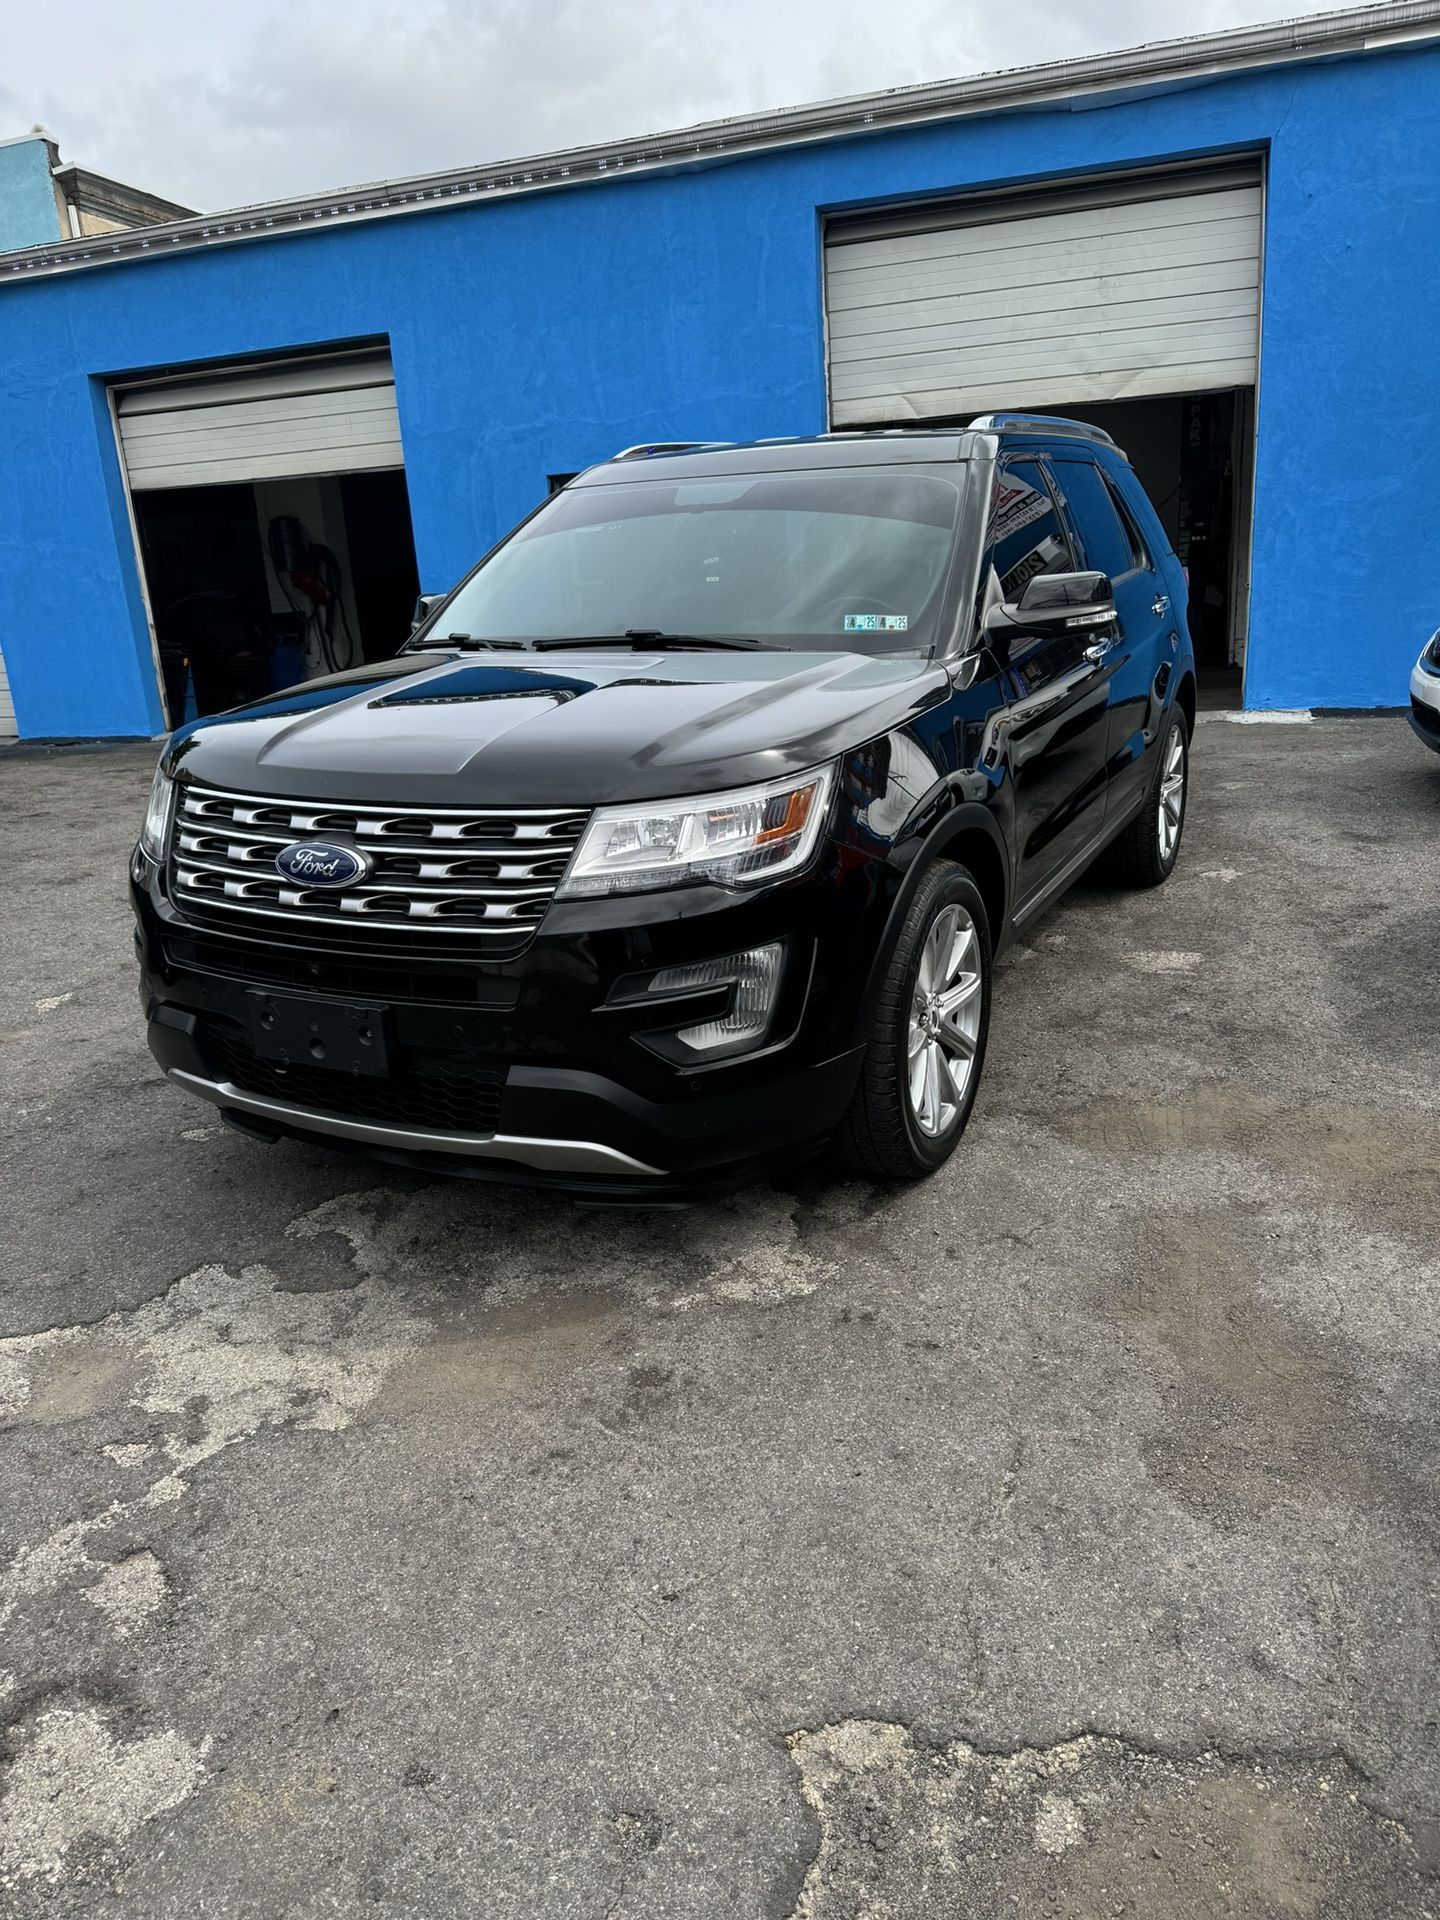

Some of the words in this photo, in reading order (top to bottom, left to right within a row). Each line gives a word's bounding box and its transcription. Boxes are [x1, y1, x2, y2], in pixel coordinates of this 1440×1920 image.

[866, 616, 875, 628] 25
[898, 617, 906, 628] 25
[290, 848, 339, 877] Ford
